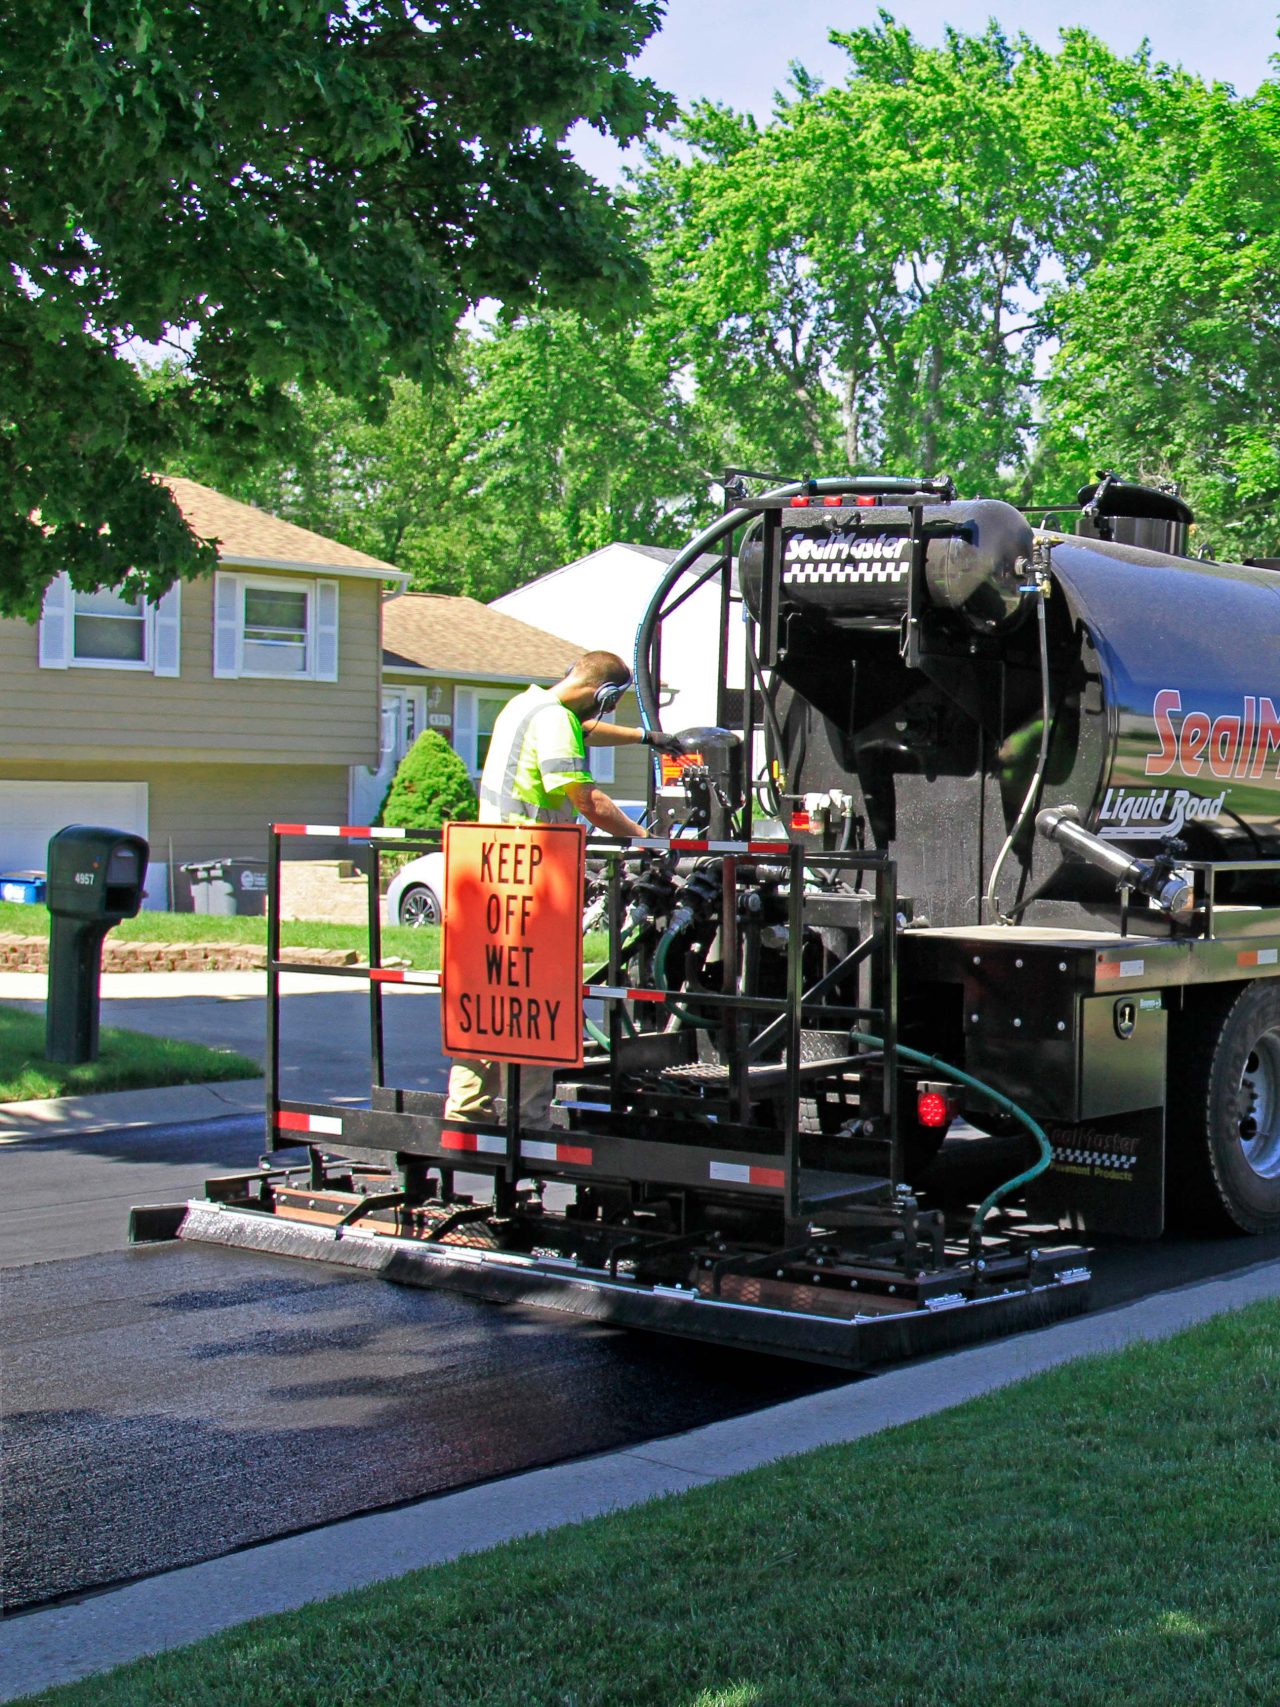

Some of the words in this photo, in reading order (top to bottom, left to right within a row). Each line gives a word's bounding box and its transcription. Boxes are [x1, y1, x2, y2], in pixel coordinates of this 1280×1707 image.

[784, 533, 909, 560] SealMaster
[1099, 788, 1170, 827] Liquid
[75, 872, 94, 885] 4957
[480, 842, 543, 885] KEEP
[486, 893, 534, 936] OFF
[485, 944, 534, 988] WET
[459, 993, 561, 1041] SLURRY
[1049, 1130, 1139, 1153] ealMaster
